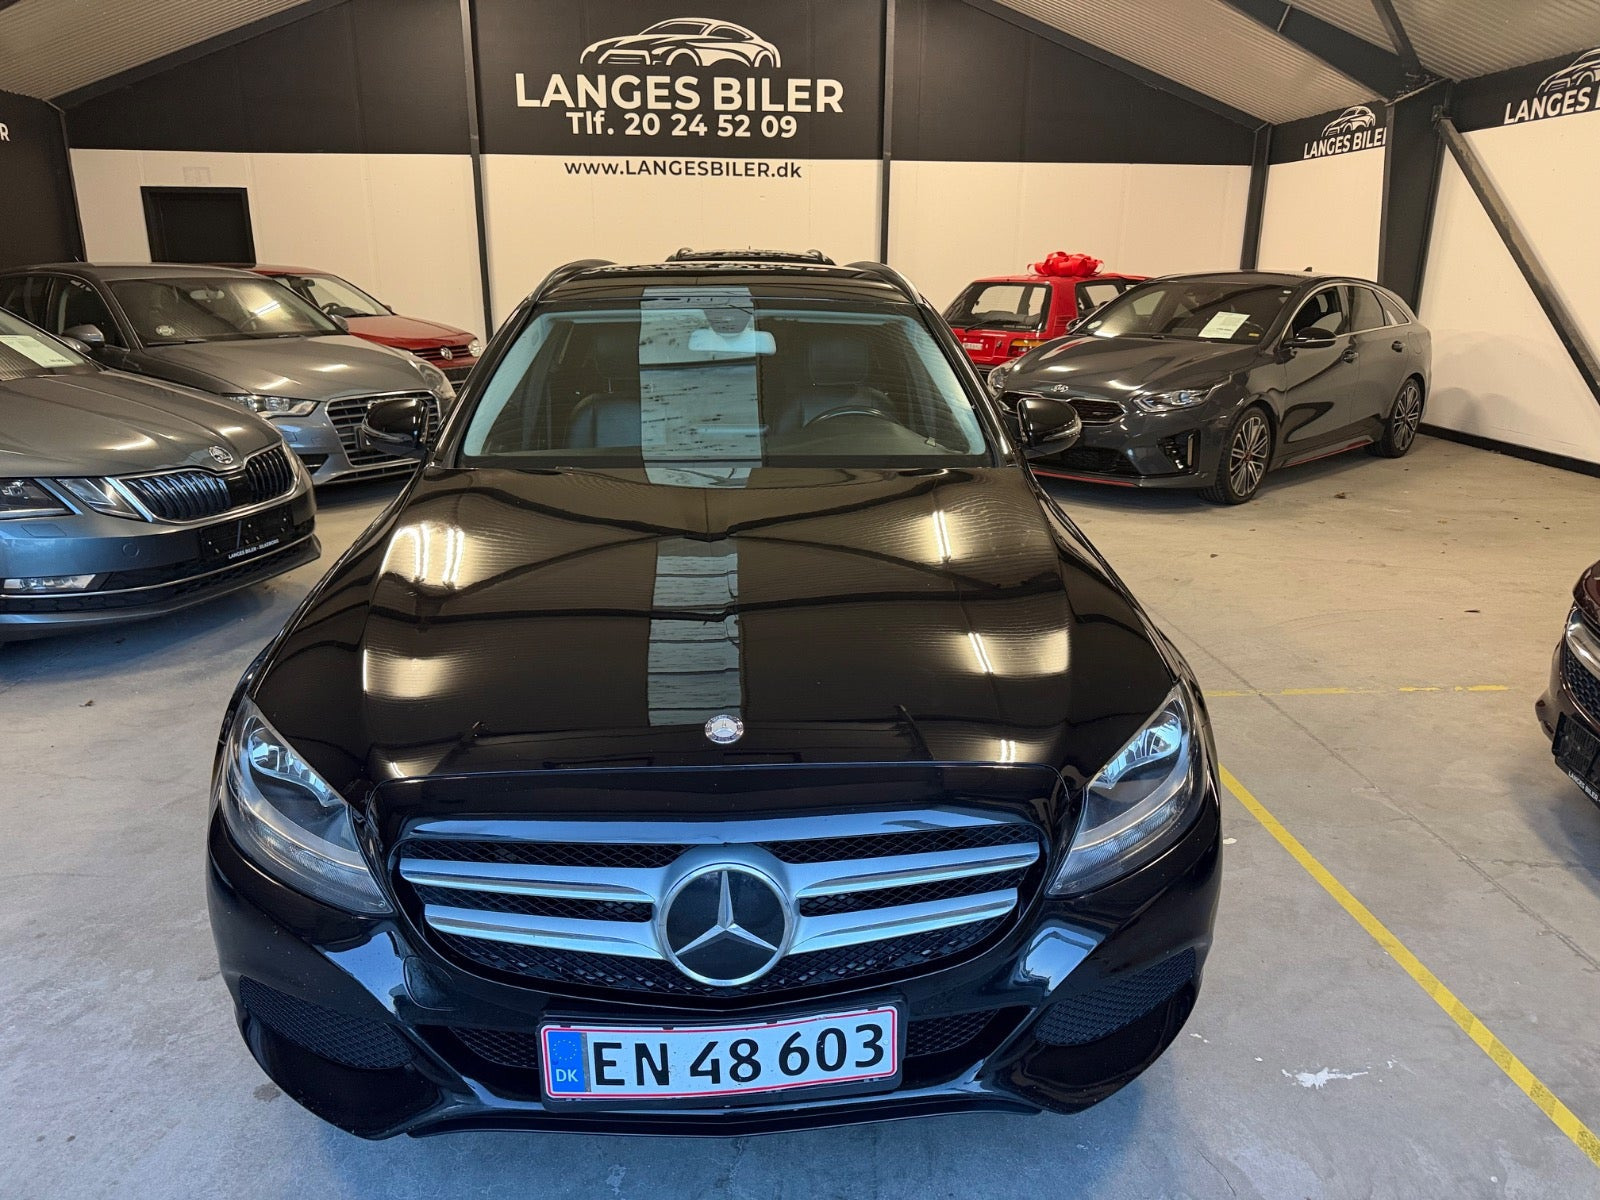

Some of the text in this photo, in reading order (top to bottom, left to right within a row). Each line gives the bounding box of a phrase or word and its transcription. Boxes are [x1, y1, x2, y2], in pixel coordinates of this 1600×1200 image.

[515, 73, 844, 113] LANGES BILER
[1504, 87, 1592, 124] LANGES
[566, 111, 798, 138] Tlf. 20 24 52 09
[1303, 127, 1387, 159] LANGES BILE
[564, 160, 802, 178] www.LANGESBILER.dk
[593, 1023, 885, 1086] EN 48 603
[556, 1068, 579, 1083] DK
